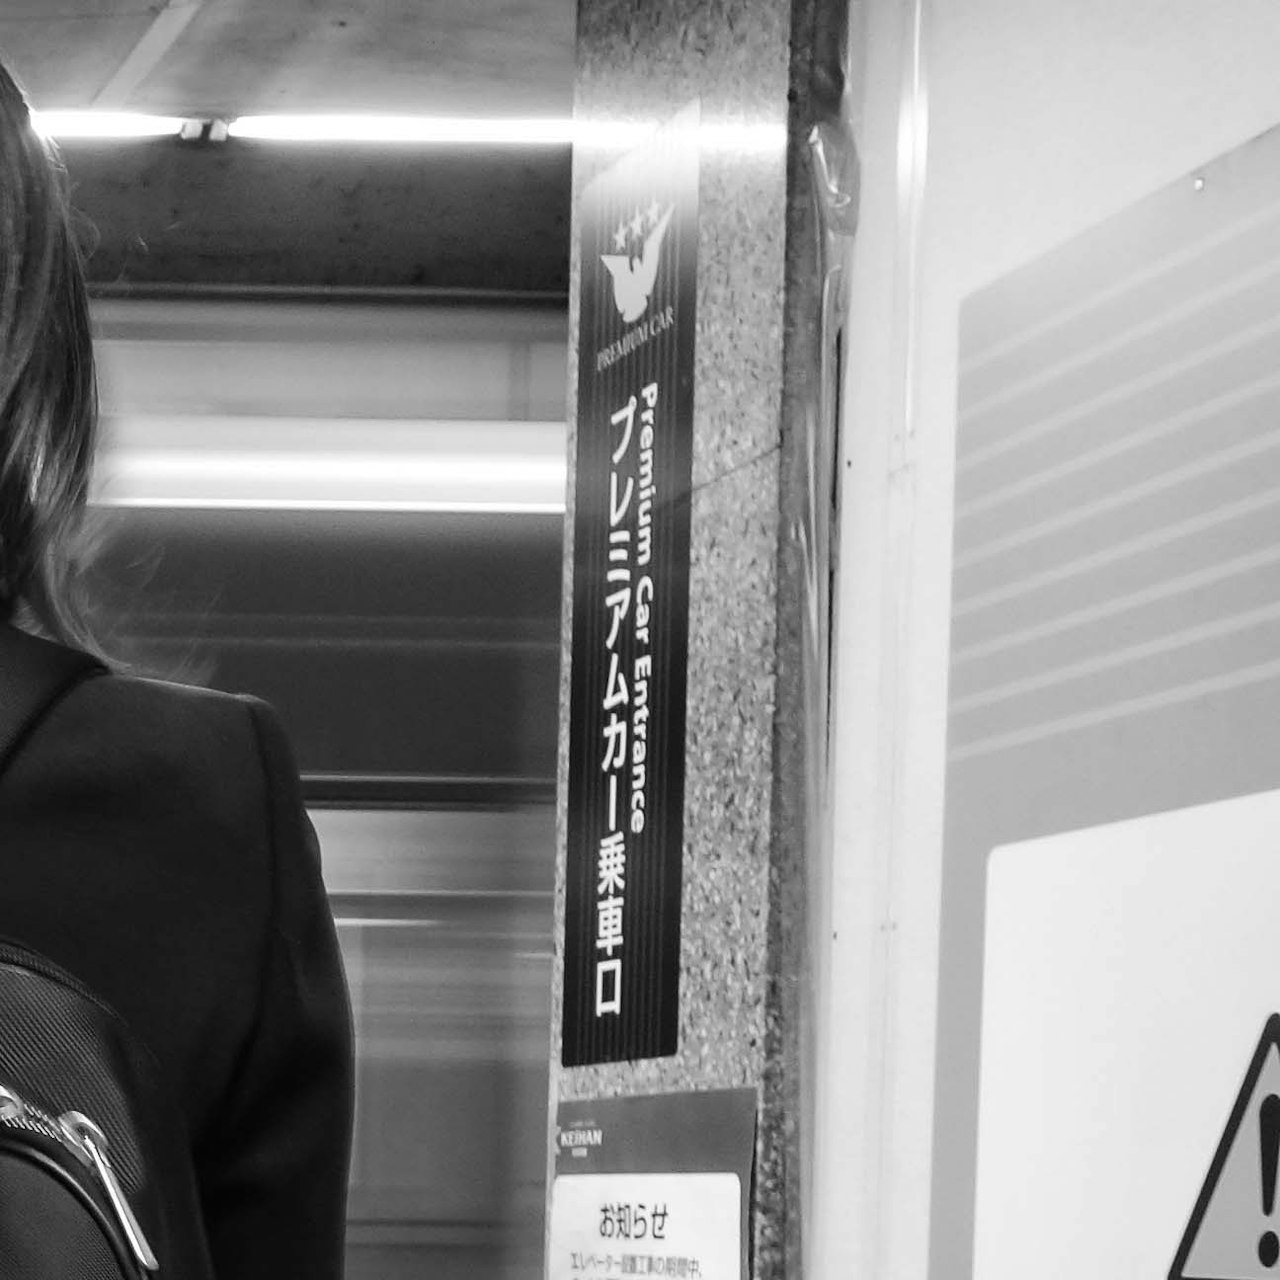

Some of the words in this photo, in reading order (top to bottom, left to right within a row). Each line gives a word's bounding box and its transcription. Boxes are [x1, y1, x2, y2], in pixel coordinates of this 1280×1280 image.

[596, 325, 649, 372] PREMIUM
[648, 305, 675, 337] CAR
[637, 382, 659, 566] Premium
[635, 575, 654, 645] Car
[595, 395, 638, 1018] プレミアムカー乗車口
[630, 654, 652, 834] Entrance
[599, 1203, 669, 1239] お知らせ
